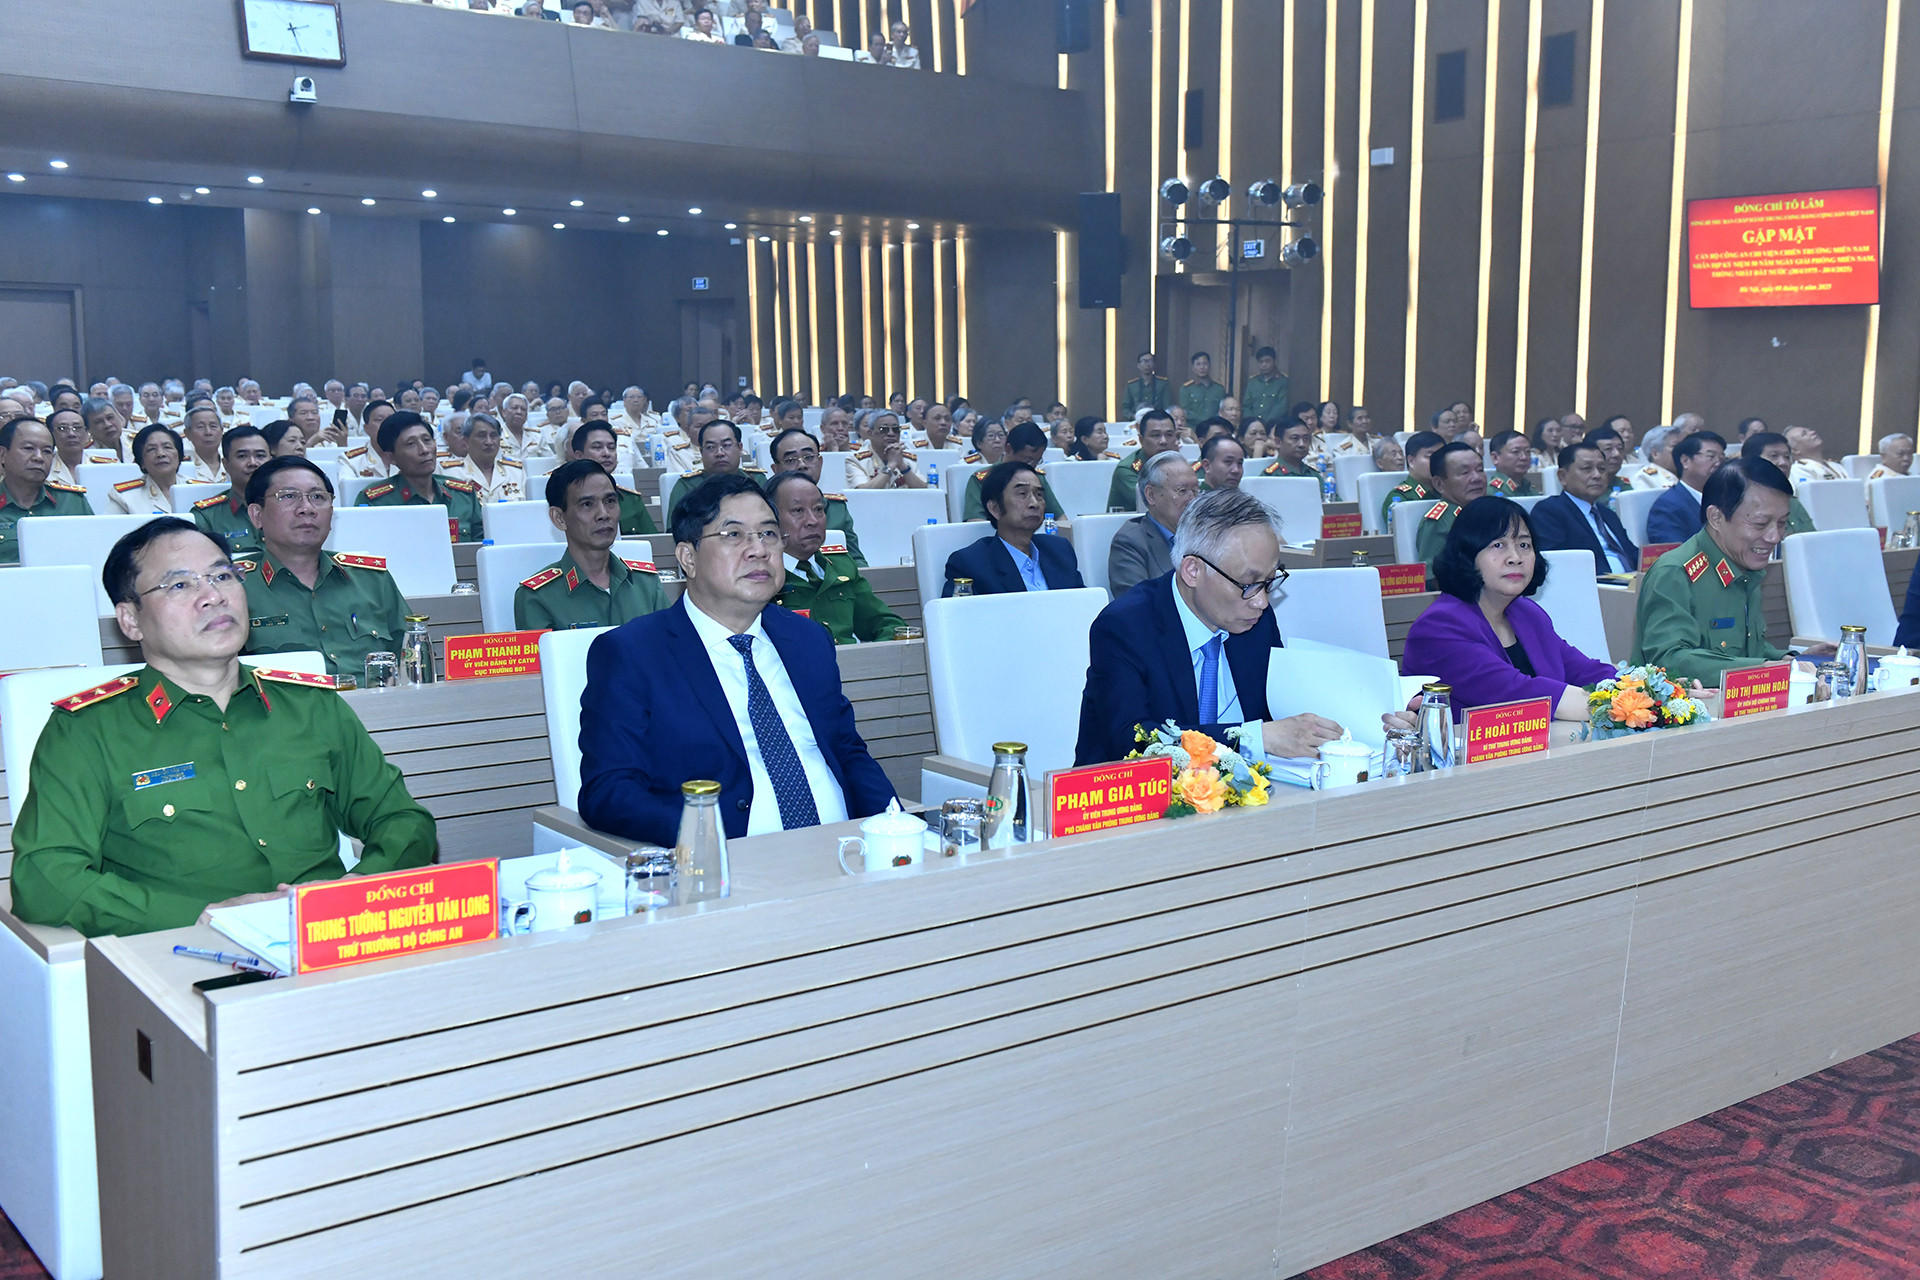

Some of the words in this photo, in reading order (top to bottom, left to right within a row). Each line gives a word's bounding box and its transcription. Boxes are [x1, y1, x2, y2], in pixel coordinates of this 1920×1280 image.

[1734, 203, 1763, 213] ĐỒNG
[1764, 200, 1782, 211] CHÍ
[1785, 198, 1799, 210] TÔ
[1801, 198, 1824, 209] LÂM
[1743, 228, 1776, 246] GẶP
[1779, 225, 1816, 244] MẶT
[451, 649, 483, 661] PHẠM
[486, 646, 520, 657] THANH
[524, 642, 540, 654] BÌN
[464, 660, 472, 668] ỦY
[1726, 687, 1739, 699] BÙI
[1740, 686, 1750, 698] THỊ
[1752, 684, 1771, 695] MINH
[1772, 679, 1788, 692] HOÀI
[1470, 727, 1482, 741] LÊ
[1485, 722, 1509, 738] HOÀI
[1513, 717, 1546, 733] TRUNG
[1093, 773, 1117, 783] ĐỒNG
[1118, 769, 1133, 779] CHÍ
[1057, 789, 1103, 811] PHẠM
[1109, 784, 1134, 803] GIA
[1139, 778, 1167, 797] TÚC
[1083, 811, 1089, 820] ỦY
[1090, 809, 1101, 819] VIÊN
[1101, 807, 1116, 817] TRUNG
[1117, 805, 1129, 815] ƯƠNG
[1130, 803, 1143, 812] ĐẢNG
[1065, 826, 1074, 834] PHÓ
[1076, 823, 1091, 833] CHÁNH
[1092, 821, 1102, 830] VĂN
[1103, 817, 1118, 829] PHÒNG
[1119, 816, 1133, 825] TRUNG
[1134, 814, 1146, 823] ƯƠNG
[1146, 811, 1159, 821] ĐẢNG
[366, 884, 407, 903] ĐỒNG
[409, 879, 434, 896] CHÍ
[306, 917, 346, 944] TRUNG
[348, 909, 387, 937] TƯỚNG
[389, 897, 435, 930] NGUYỄN
[436, 898, 459, 921] VĂN
[462, 894, 490, 916] LONG
[337, 940, 359, 959] THỨ
[361, 934, 401, 955] TRƯỞNG
[403, 933, 417, 950] BỘ
[419, 929, 447, 945] CÔNG
[448, 926, 463, 940] AN
